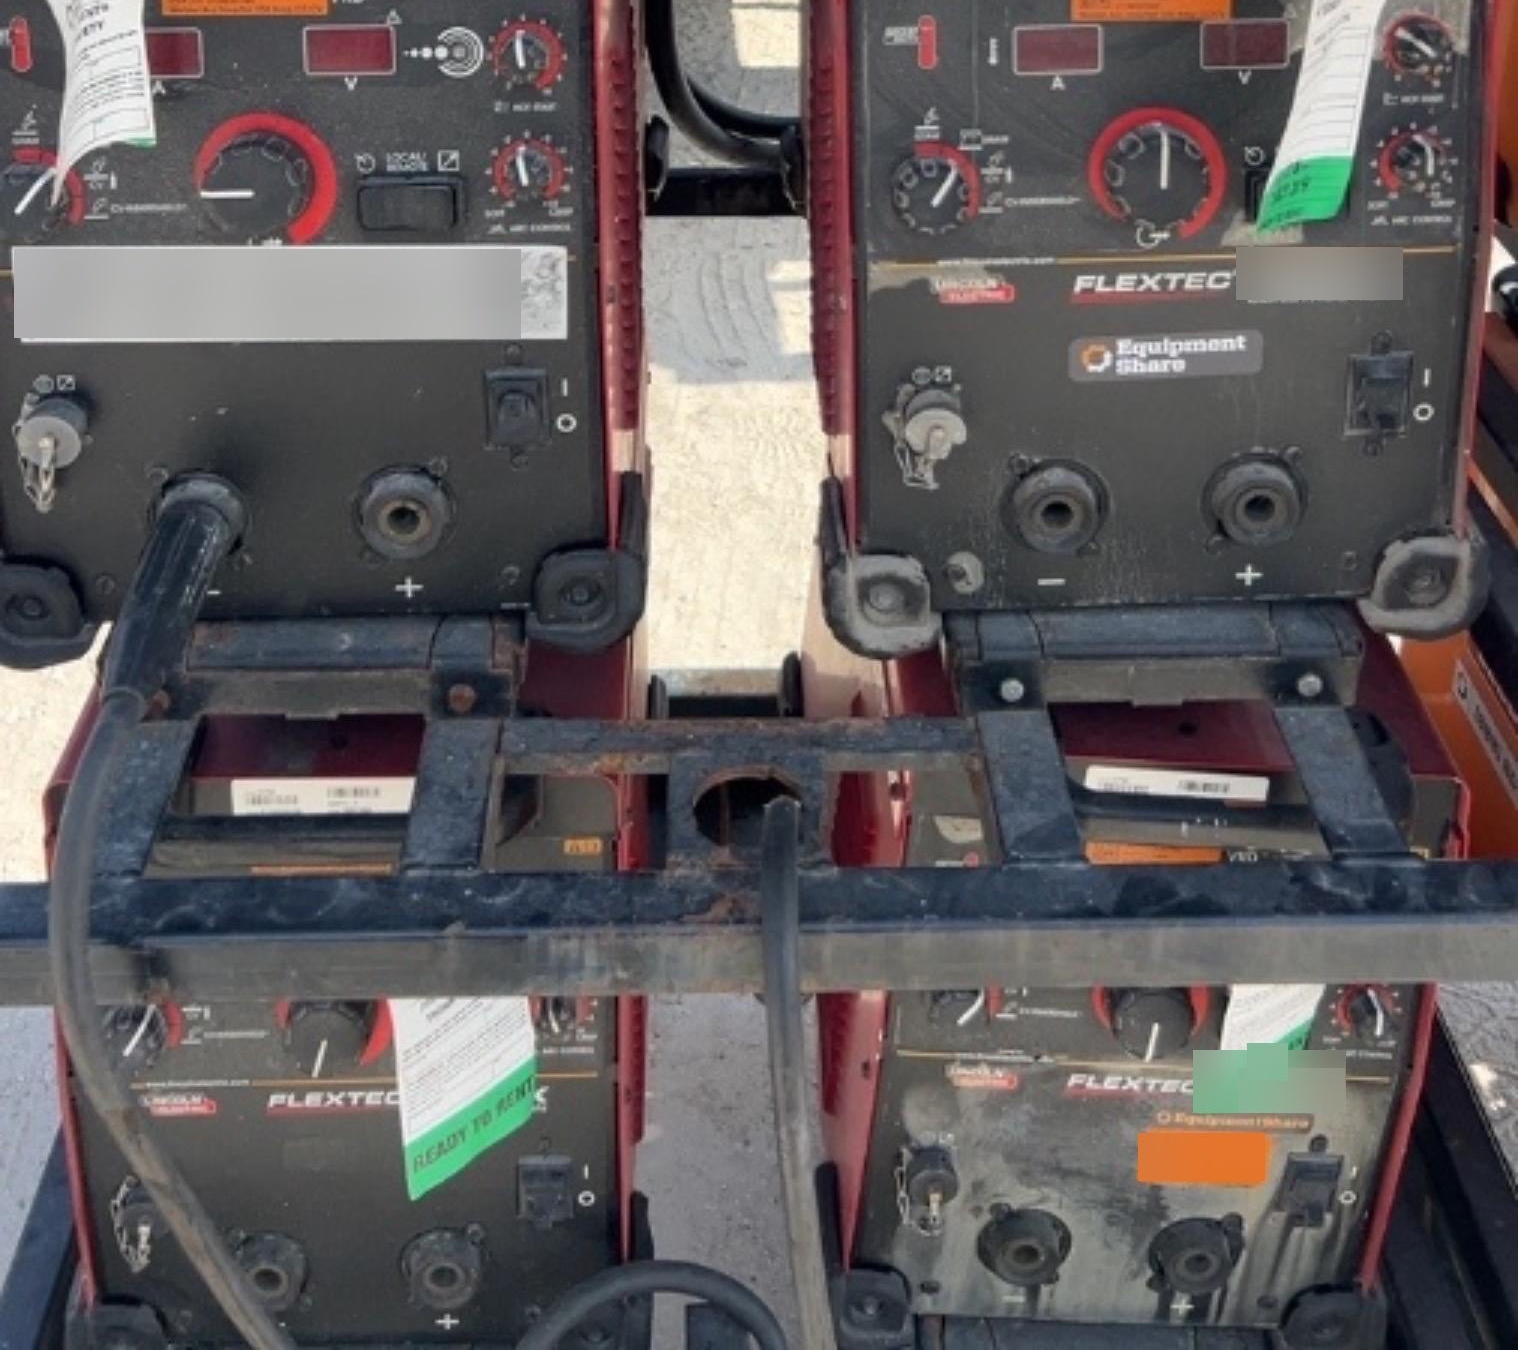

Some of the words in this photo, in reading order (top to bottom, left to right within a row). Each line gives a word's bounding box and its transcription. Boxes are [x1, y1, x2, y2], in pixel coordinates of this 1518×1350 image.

[343, 77, 359, 91] V
[1050, 75, 1066, 91] A
[1236, 70, 1252, 85] V
[1073, 271, 1233, 295] FLEXTEC
[1116, 335, 1247, 356] Equipment
[1116, 357, 1187, 375] Share
[413, 1123, 469, 1174] READY
[473, 1112, 493, 1134] TO
[496, 1074, 534, 1118] RENT
